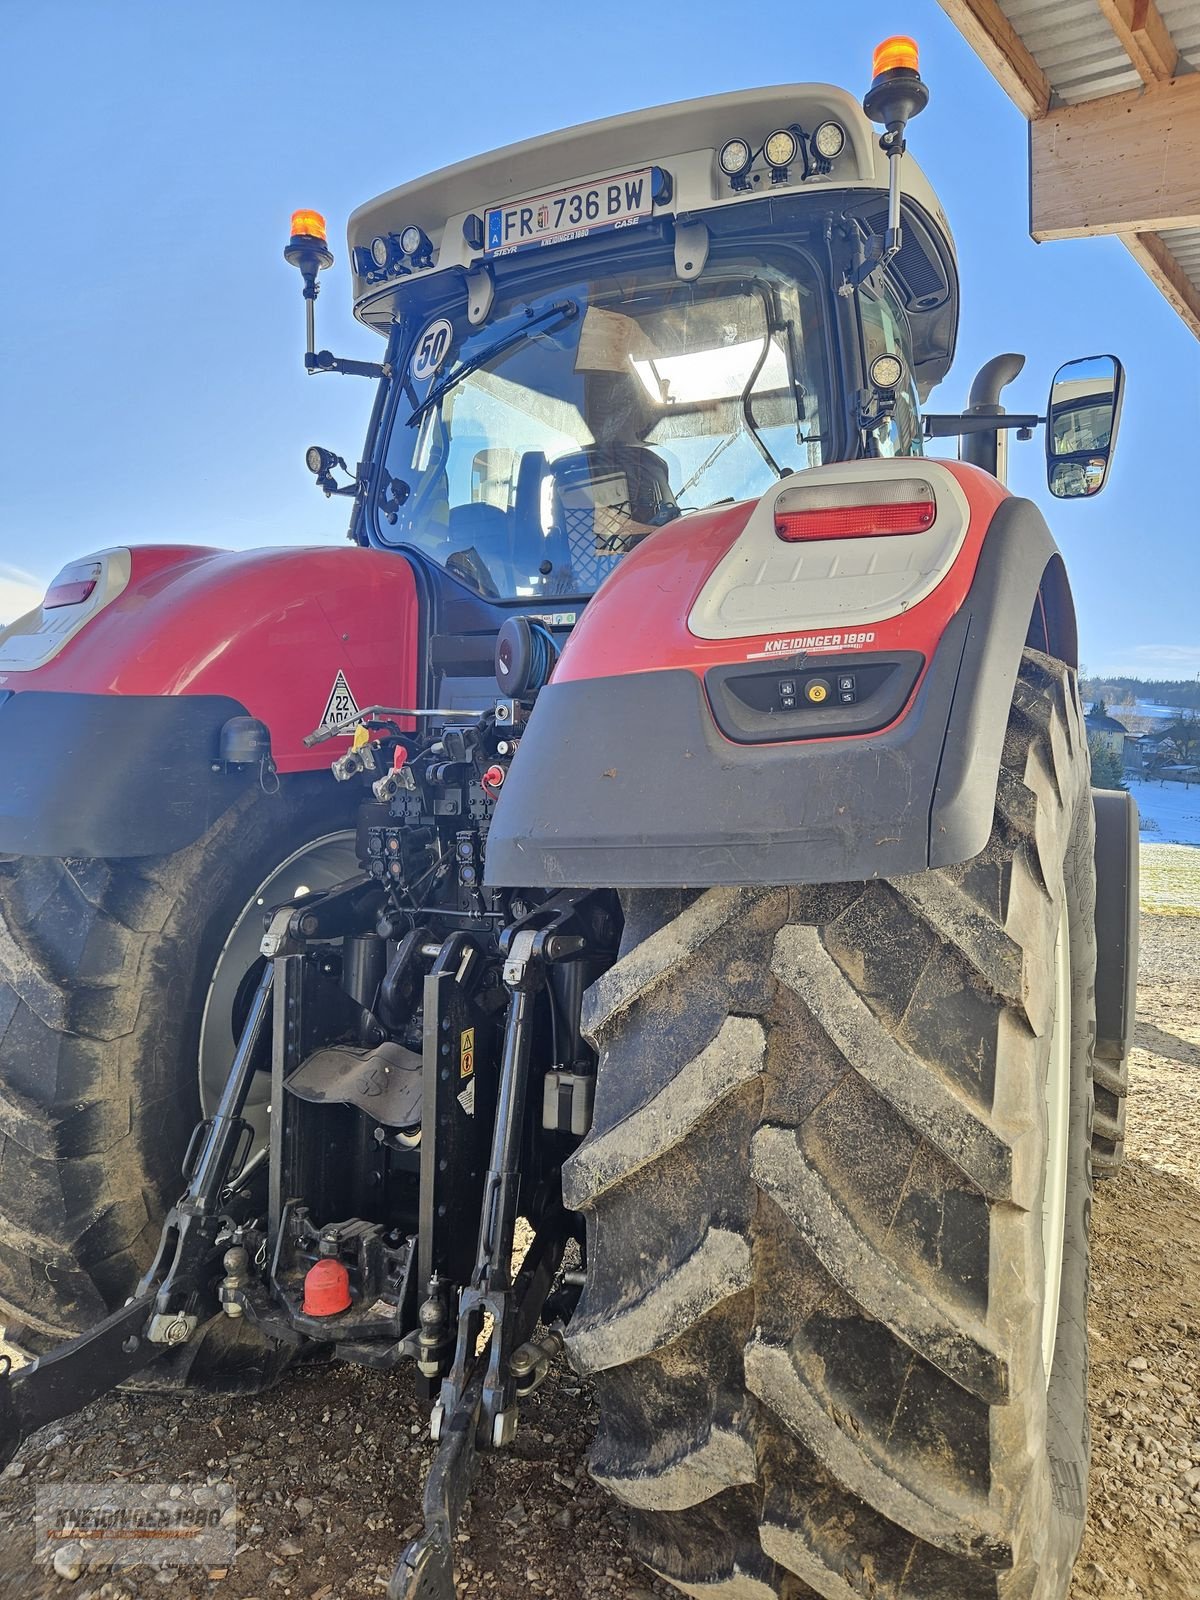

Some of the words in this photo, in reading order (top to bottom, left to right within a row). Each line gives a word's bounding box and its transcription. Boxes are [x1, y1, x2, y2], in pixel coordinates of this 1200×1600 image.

[504, 207, 534, 241] FR
[553, 190, 600, 229] 736
[607, 178, 644, 216] BW
[614, 216, 640, 230] CASE
[491, 234, 499, 244] A
[540, 231, 575, 247] KNEIDINGER
[493, 246, 518, 258] STEYR
[416, 328, 448, 372] 50
[764, 635, 841, 652] KNEIDINGER
[843, 632, 876, 645] 1880
[335, 695, 350, 711] 22
